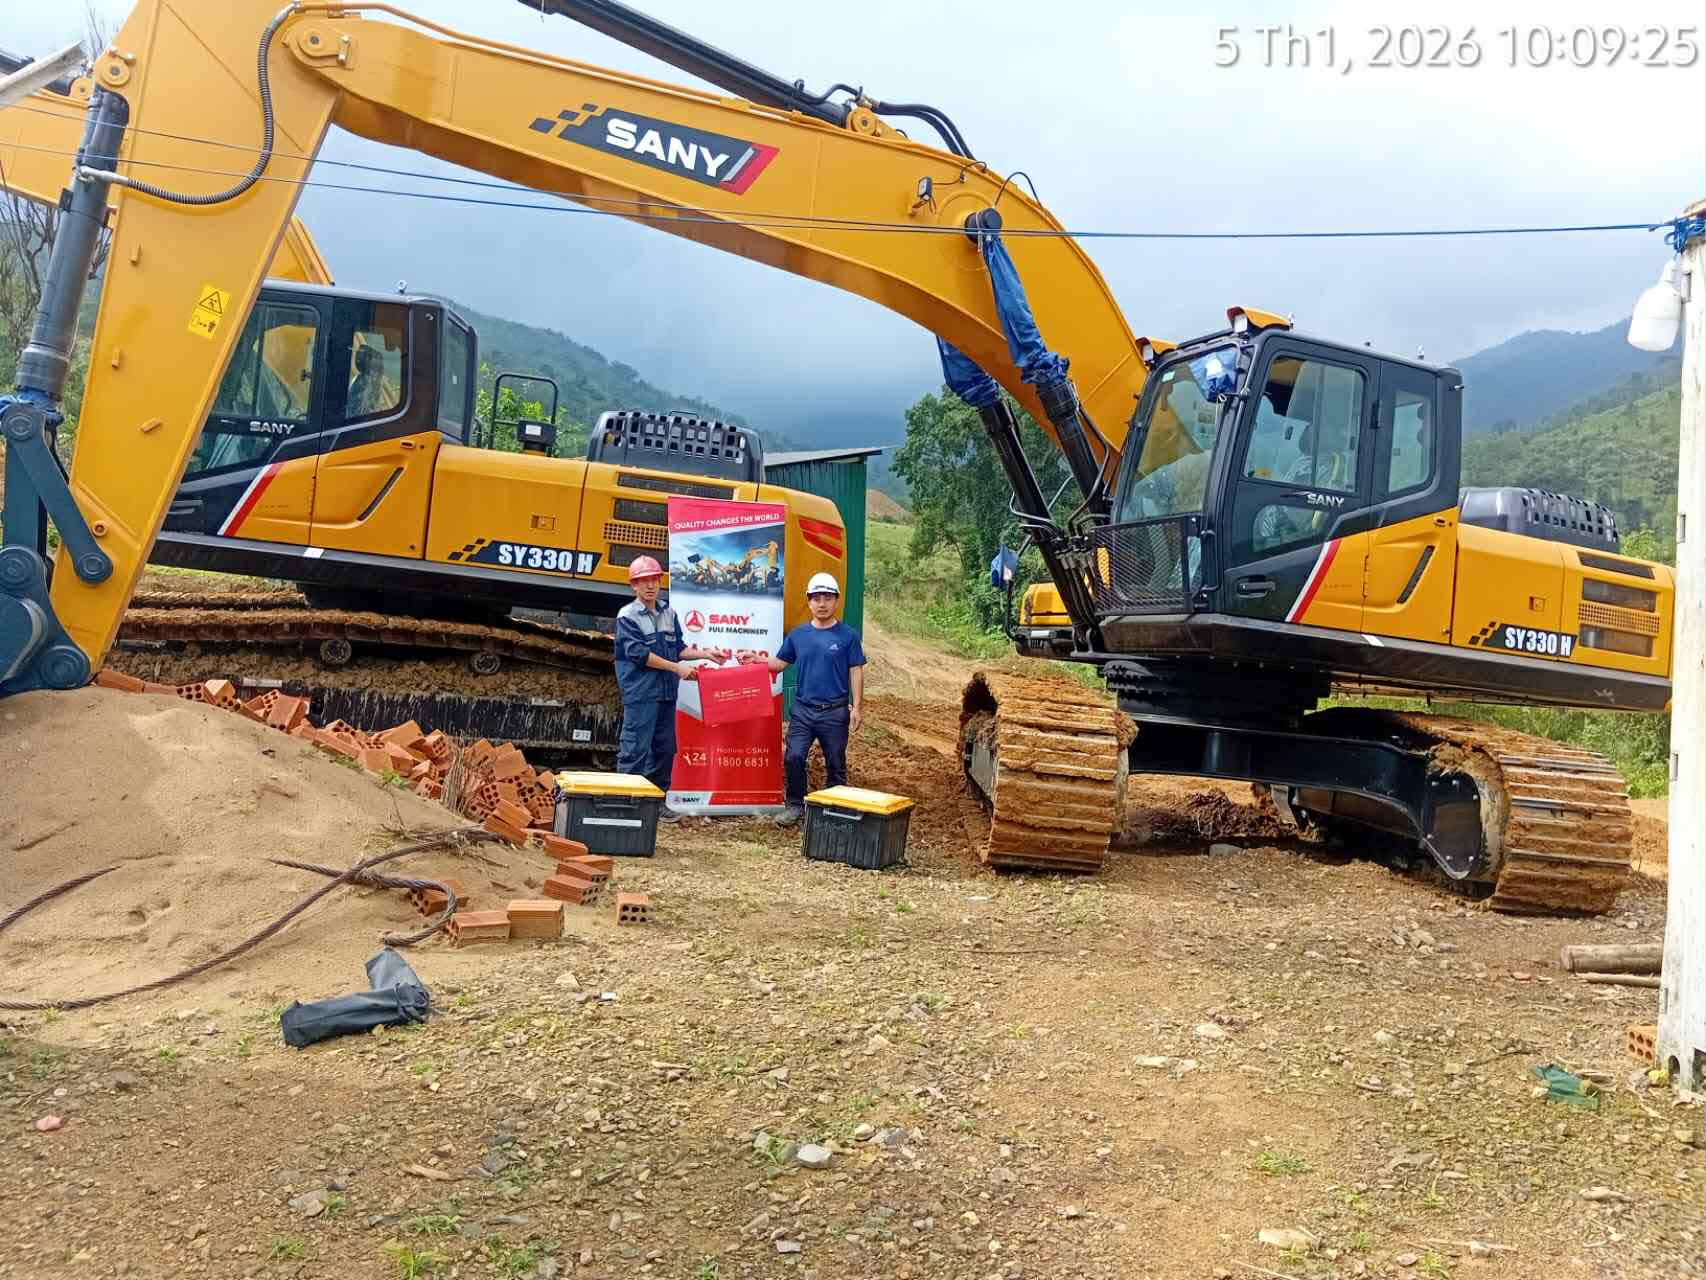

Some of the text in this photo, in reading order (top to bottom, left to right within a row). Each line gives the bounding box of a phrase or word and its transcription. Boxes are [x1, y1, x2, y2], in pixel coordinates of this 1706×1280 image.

[606, 117, 730, 178] SANY
[249, 420, 295, 435] SANY
[1307, 493, 1344, 508] SANY
[674, 513, 779, 530] QUALITY CHANGES THE WORLD
[709, 614, 749, 625] SANY
[726, 626, 768, 635] MACHINERY
[718, 757, 769, 768] 1800 6831
